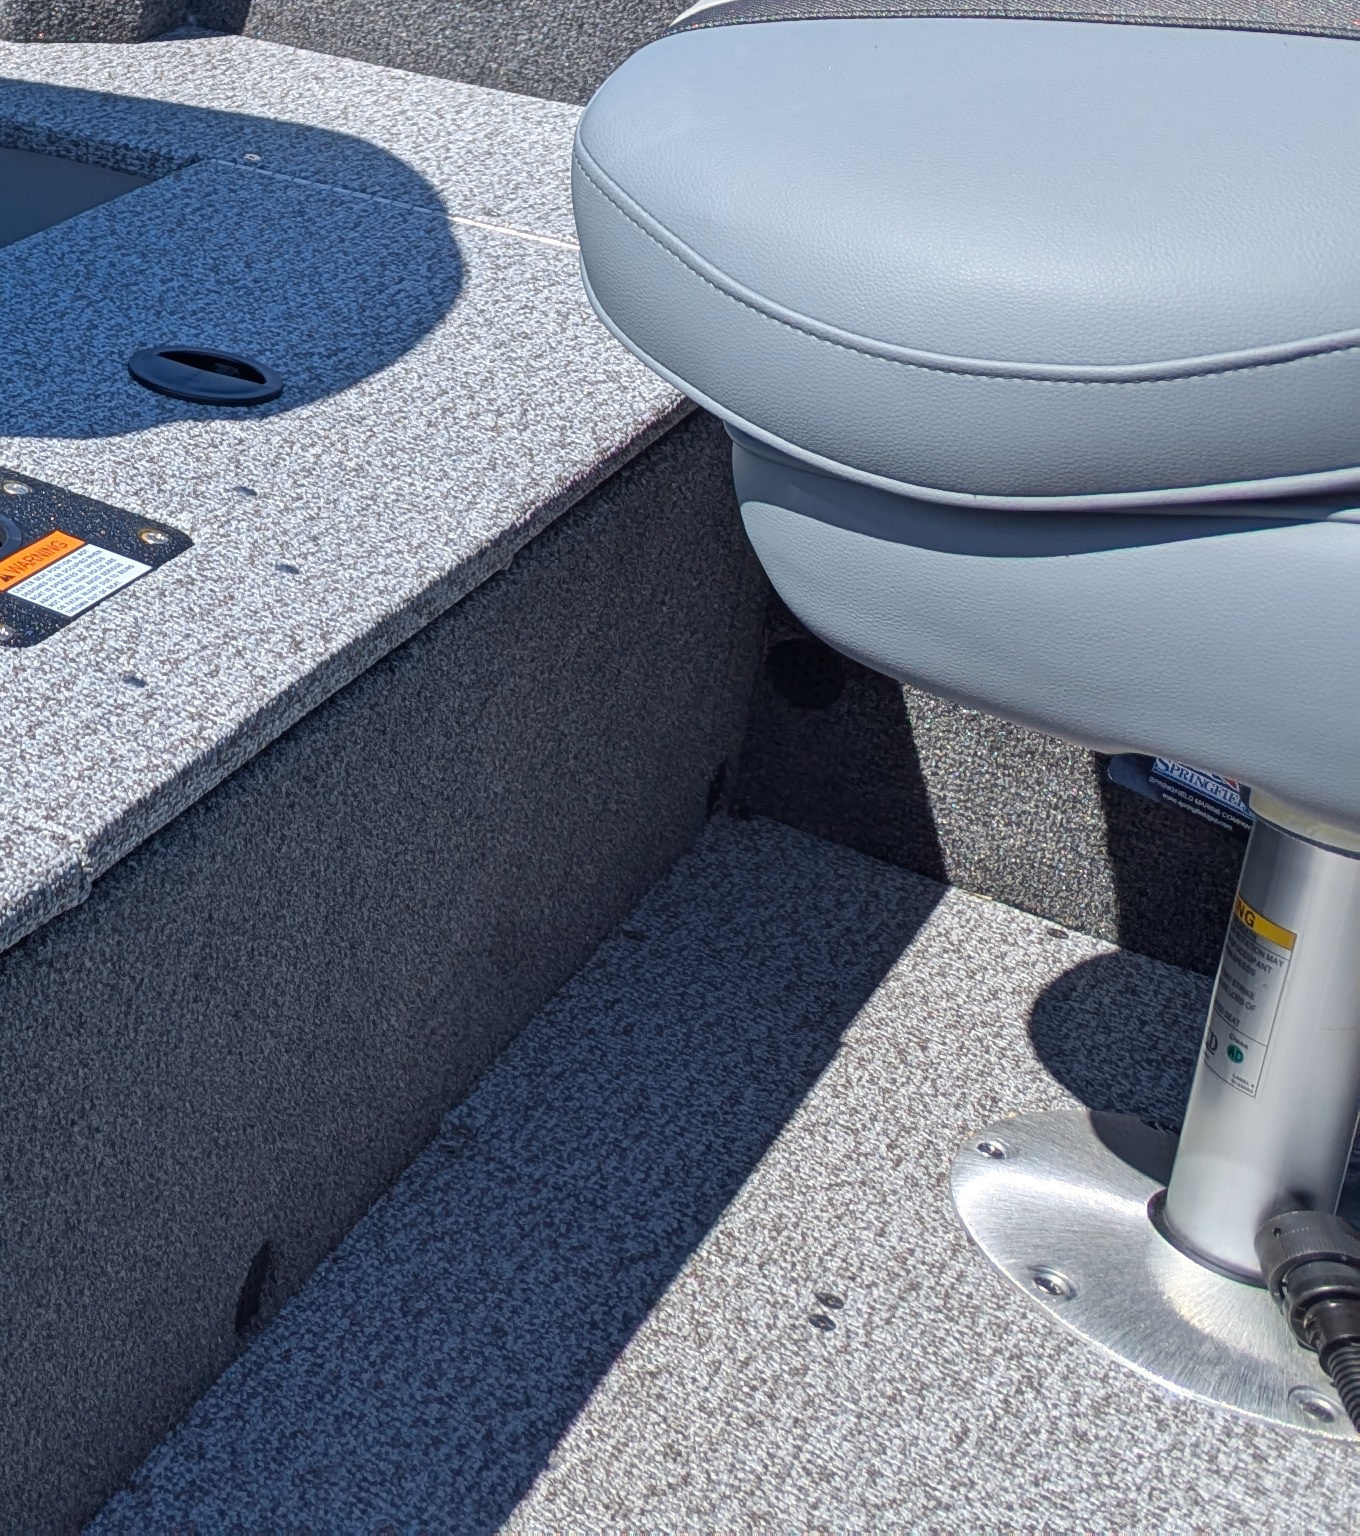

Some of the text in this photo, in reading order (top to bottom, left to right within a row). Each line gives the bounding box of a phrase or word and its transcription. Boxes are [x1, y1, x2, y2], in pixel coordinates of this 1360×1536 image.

[4, 541, 68, 574] WARNING
[1154, 756, 1250, 813] SPRINGFIEL
[1236, 899, 1256, 928] NG
